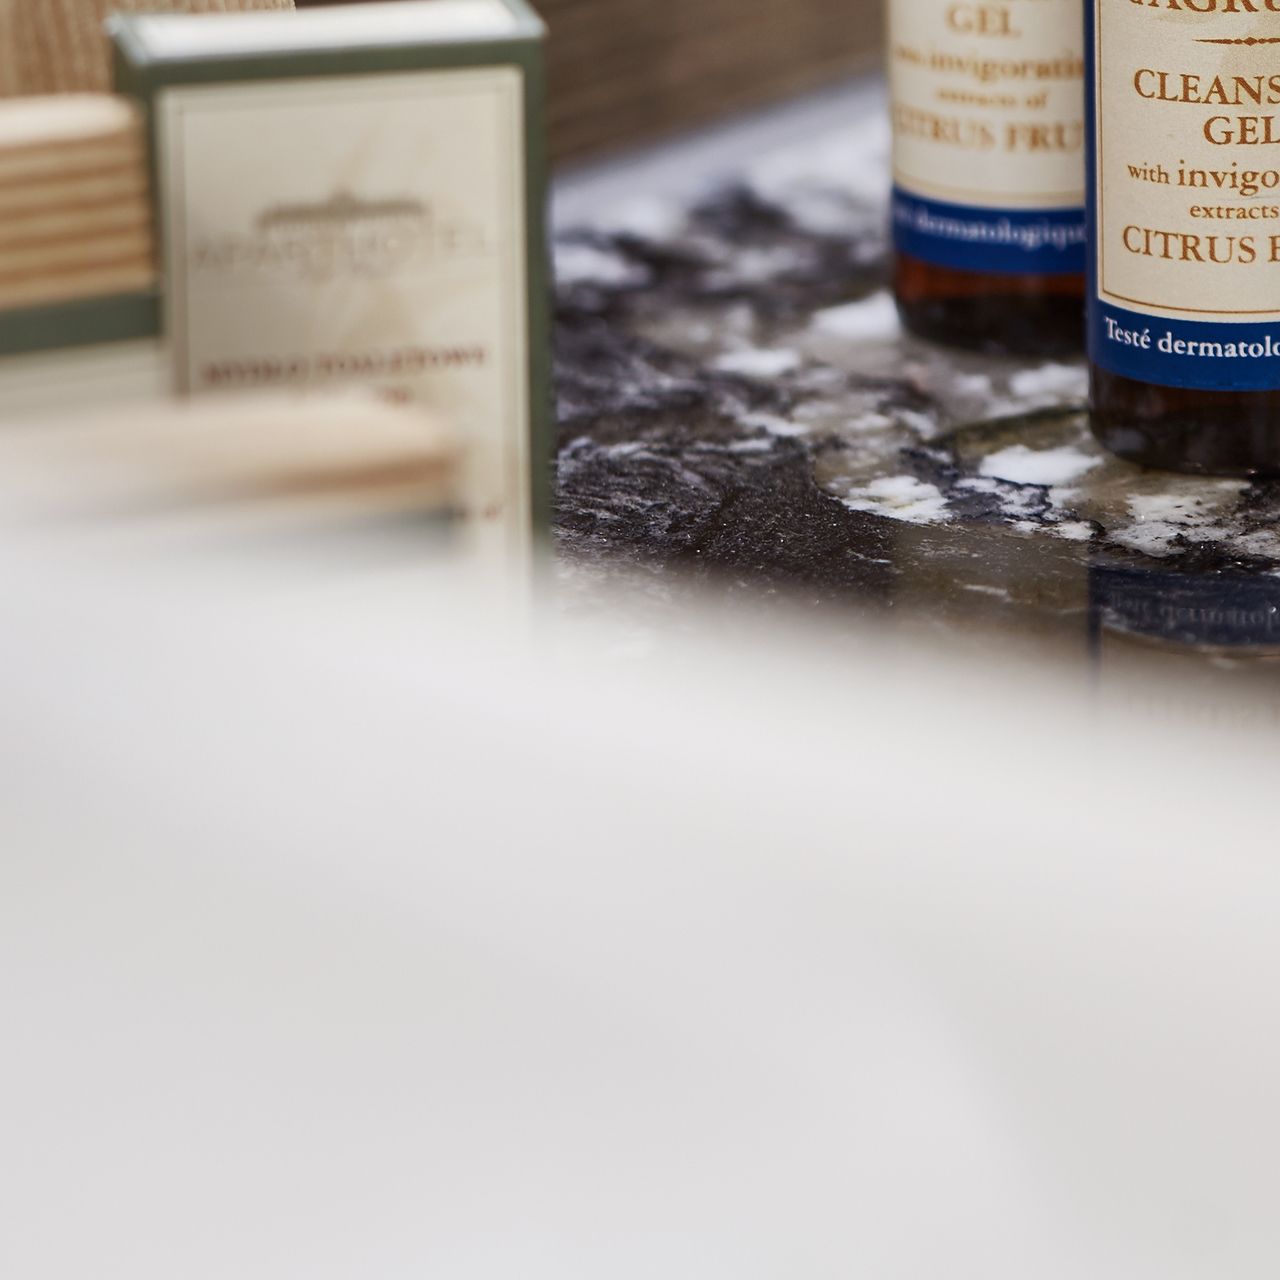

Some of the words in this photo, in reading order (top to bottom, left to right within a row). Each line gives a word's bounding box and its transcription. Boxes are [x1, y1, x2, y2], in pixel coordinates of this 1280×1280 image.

[945, 3, 1022, 37] GEL
[1127, 161, 1169, 185] with
[1189, 203, 1279, 220] extracts
[1122, 225, 1256, 264] CITRUS
[1104, 316, 1151, 349] Testé
